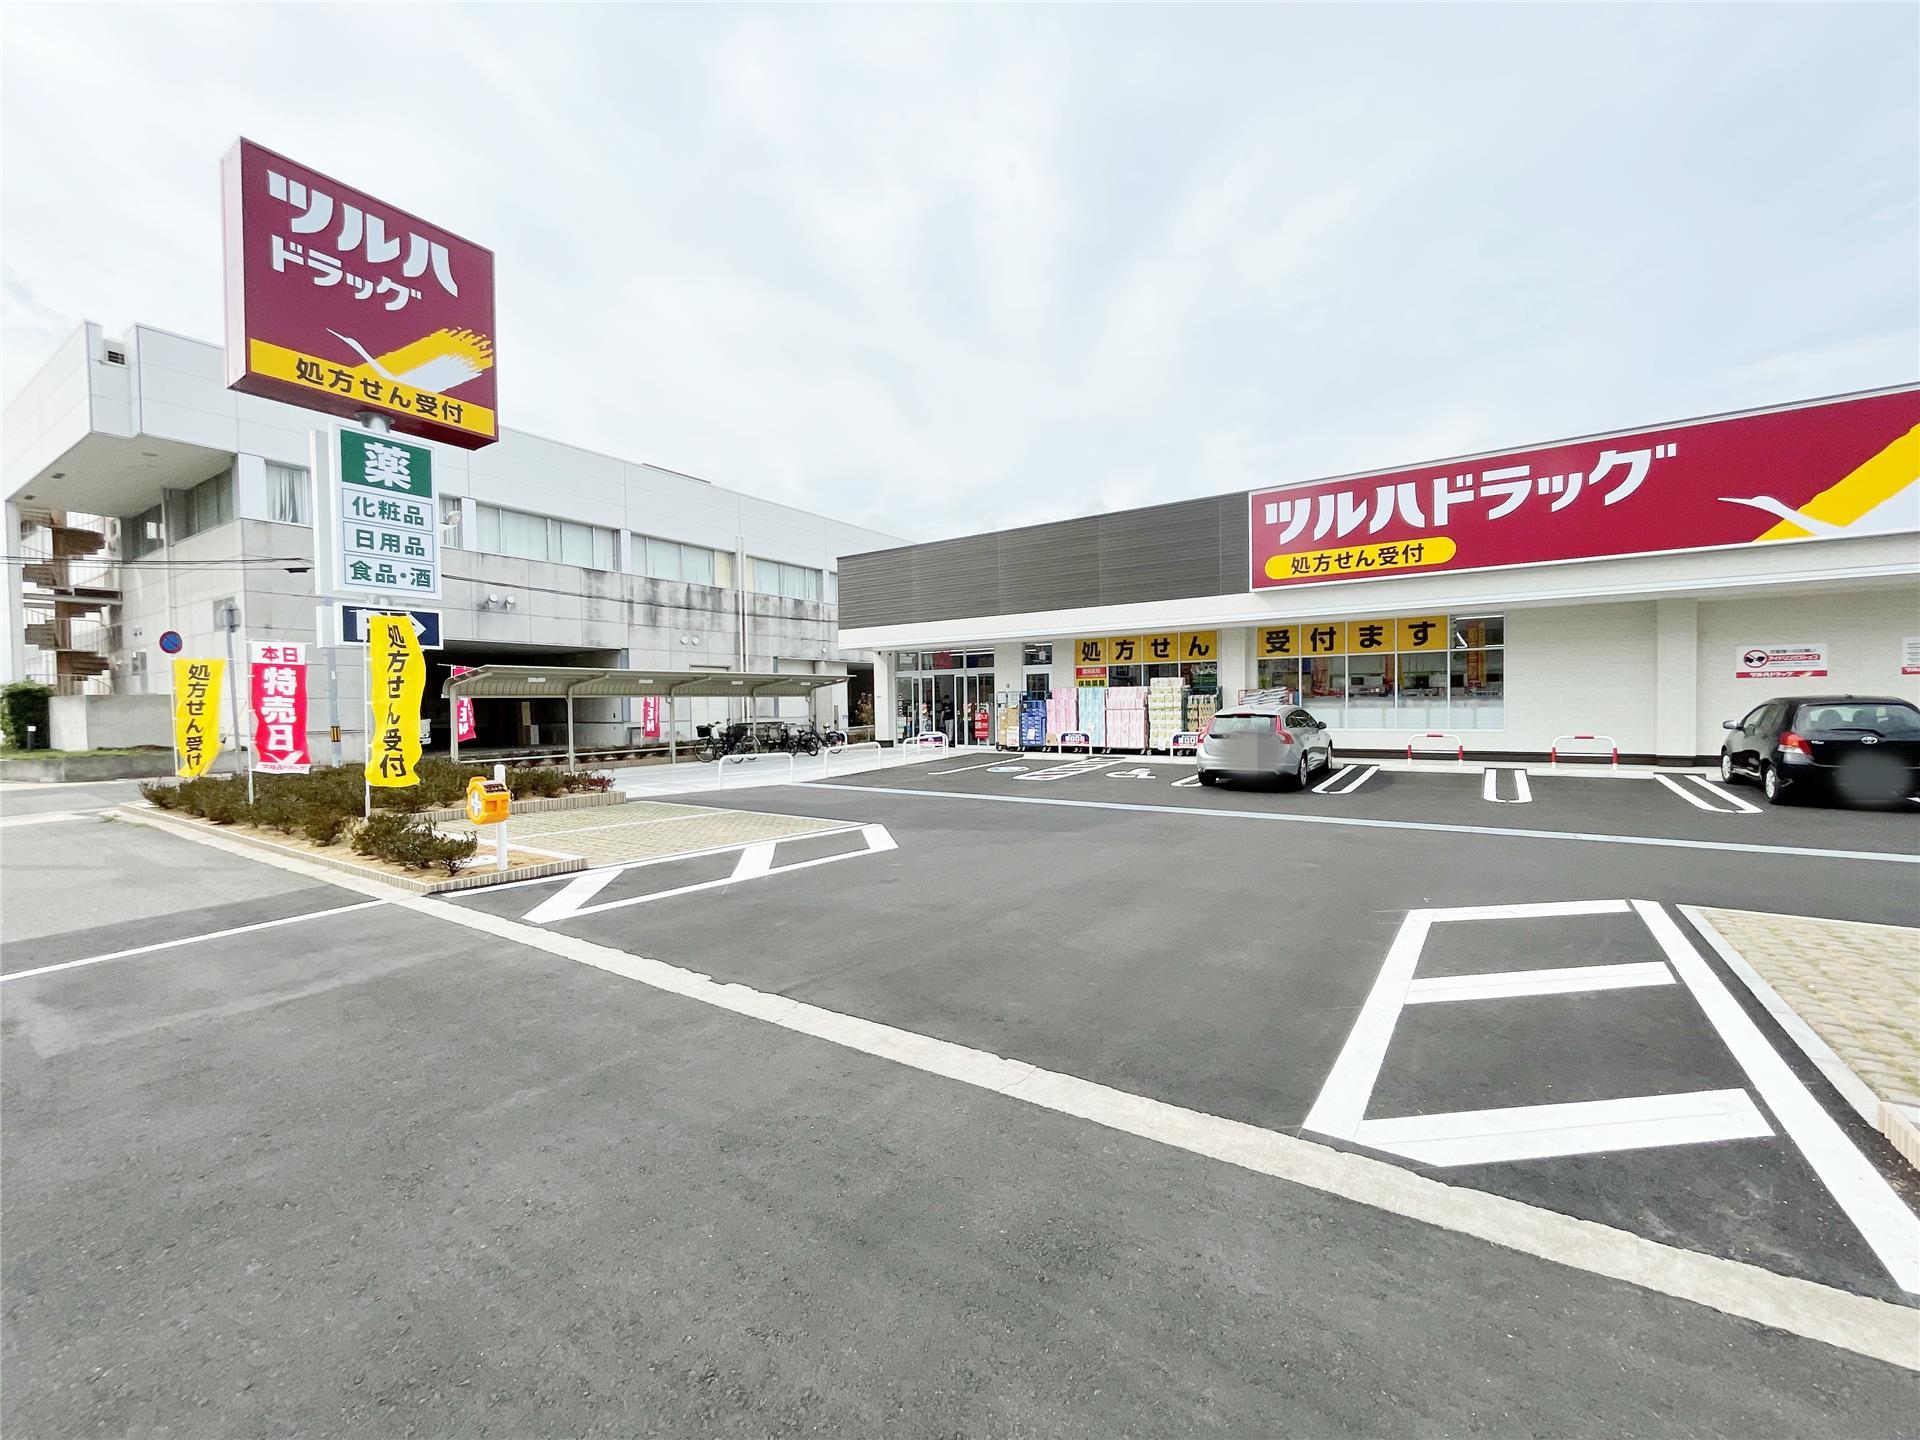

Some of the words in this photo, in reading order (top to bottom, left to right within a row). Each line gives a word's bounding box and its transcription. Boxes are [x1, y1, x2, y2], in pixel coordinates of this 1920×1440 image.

[267, 169, 458, 298] ツルハ
[271, 234, 421, 311] ドラッグ
[296, 358, 463, 424] 処方せん受付
[364, 441, 412, 490] 薬
[352, 496, 424, 526] 化粧品
[1265, 443, 1677, 545] ツルハドラッグ
[356, 529, 425, 557] 日用品
[1291, 544, 1424, 576] 処方せん受付
[350, 560, 431, 588] 食品・酒
[261, 646, 298, 662] 本日
[1081, 635, 1210, 662] 処方せん
[1265, 621, 1436, 653] 受付ます
[261, 667, 297, 751] 特売日
[380, 624, 410, 779] 処方せん受付
